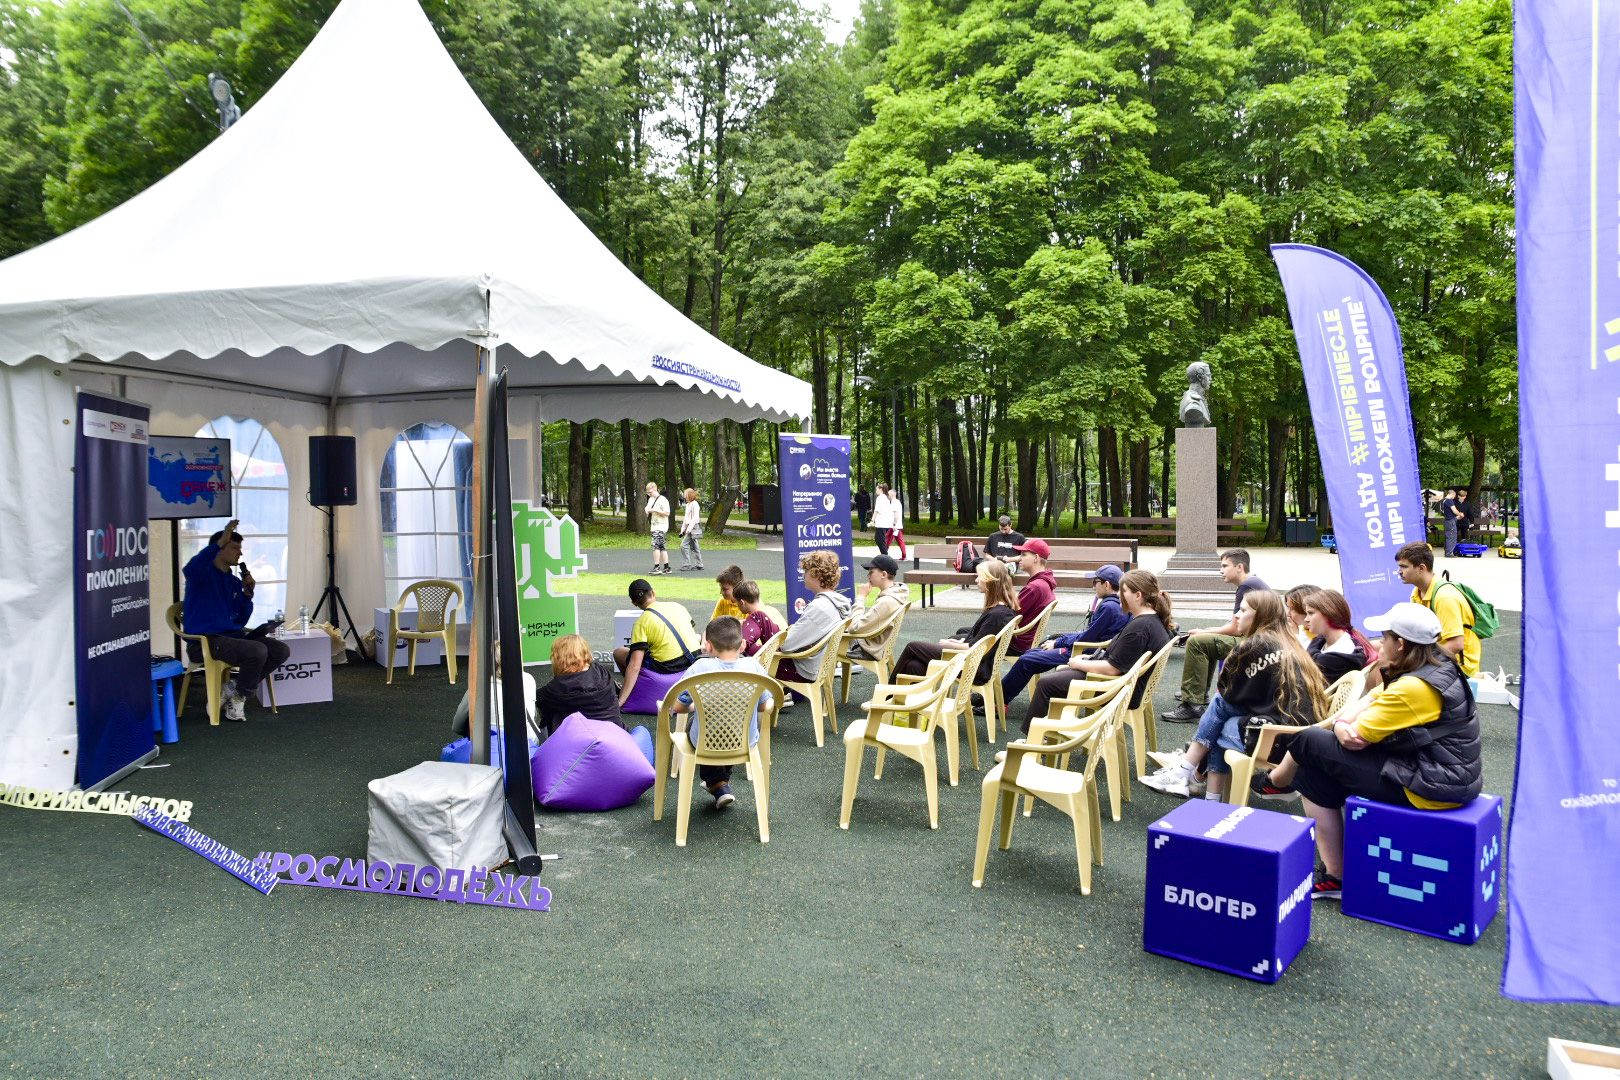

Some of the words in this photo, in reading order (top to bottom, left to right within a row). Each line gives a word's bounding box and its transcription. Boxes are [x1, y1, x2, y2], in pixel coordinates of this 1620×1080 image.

[798, 538, 843, 548] поколения
[87, 565, 149, 592] поколения
[252, 850, 553, 911] #РОСМОЛОДЁЖЬ
[1278, 871, 1314, 923] ПИАРЩИК
[1164, 884, 1256, 920] БЛОГЕР
